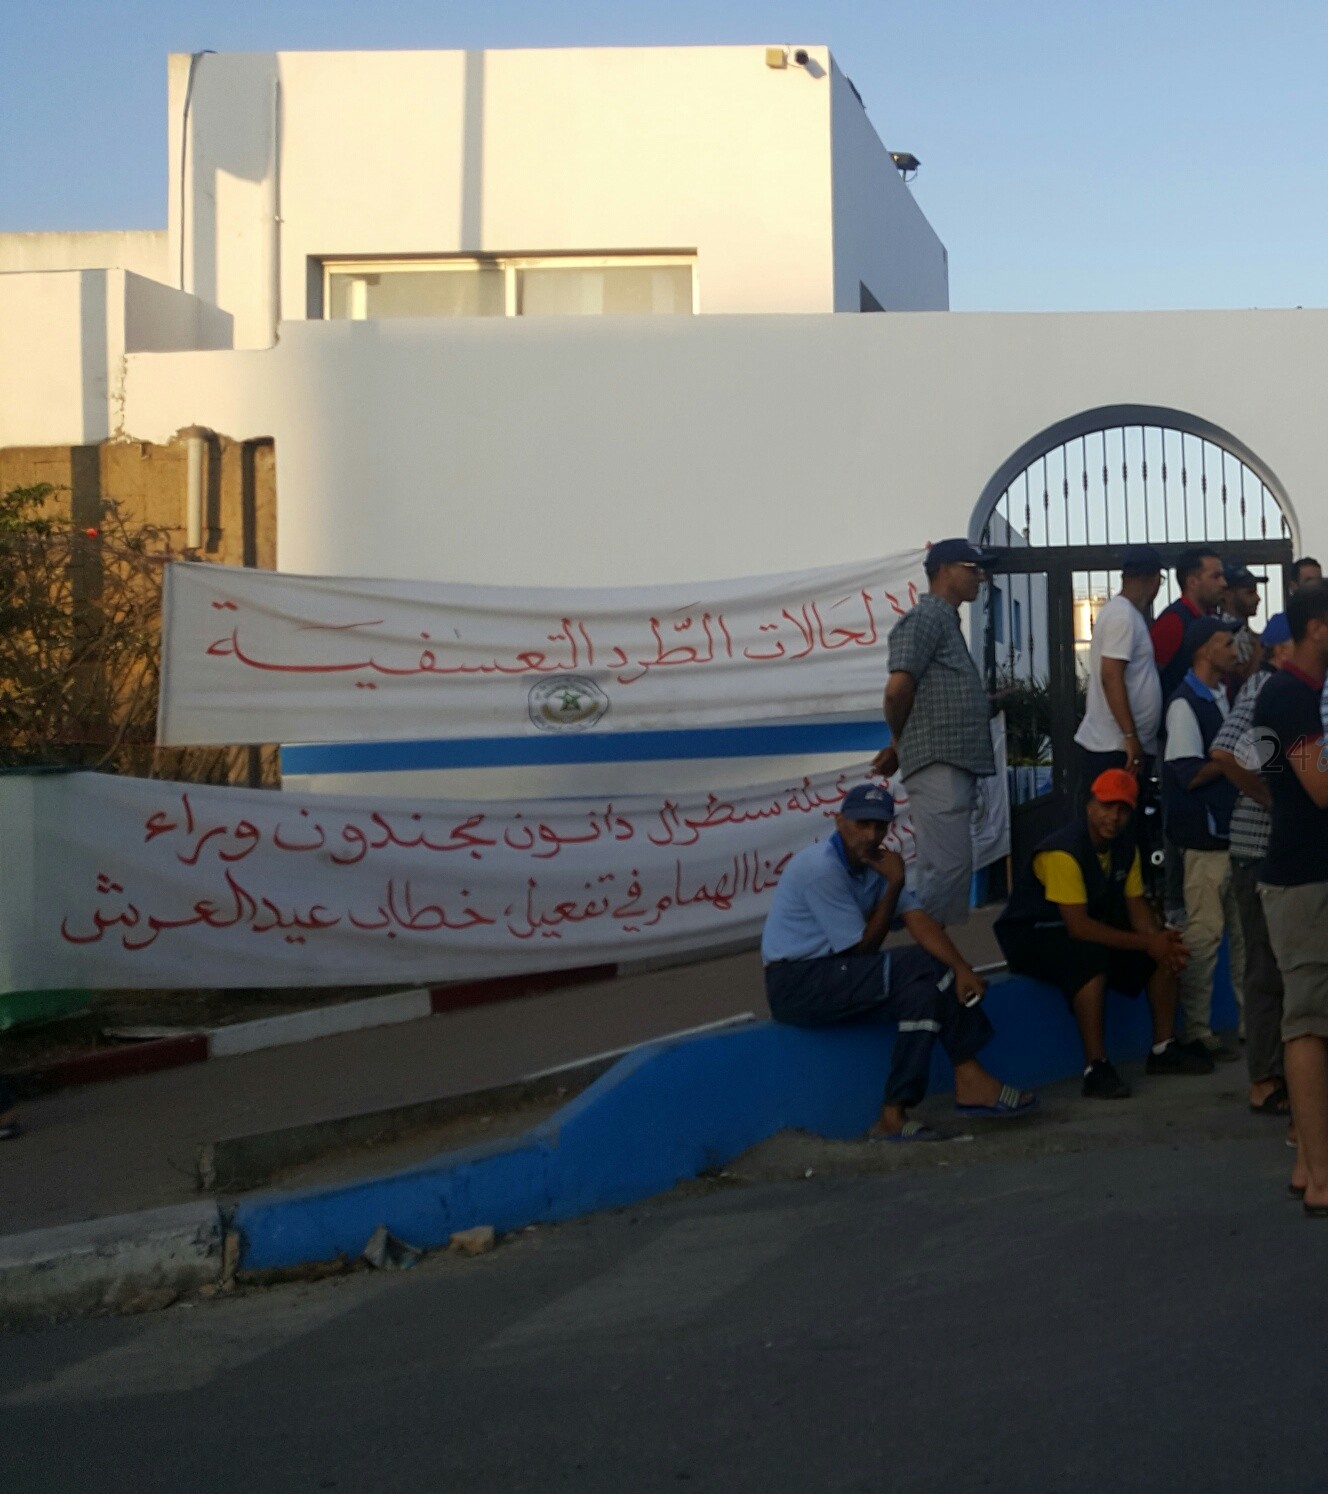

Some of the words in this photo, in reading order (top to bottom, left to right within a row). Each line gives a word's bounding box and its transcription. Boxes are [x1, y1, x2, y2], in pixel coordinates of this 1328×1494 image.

[144, 792, 261, 866] وراء
[503, 802, 635, 858] دانون
[61, 868, 257, 950] العرش
[252, 897, 342, 944] عيد
[348, 879, 497, 939] خطاب
[611, 869, 647, 932] في
